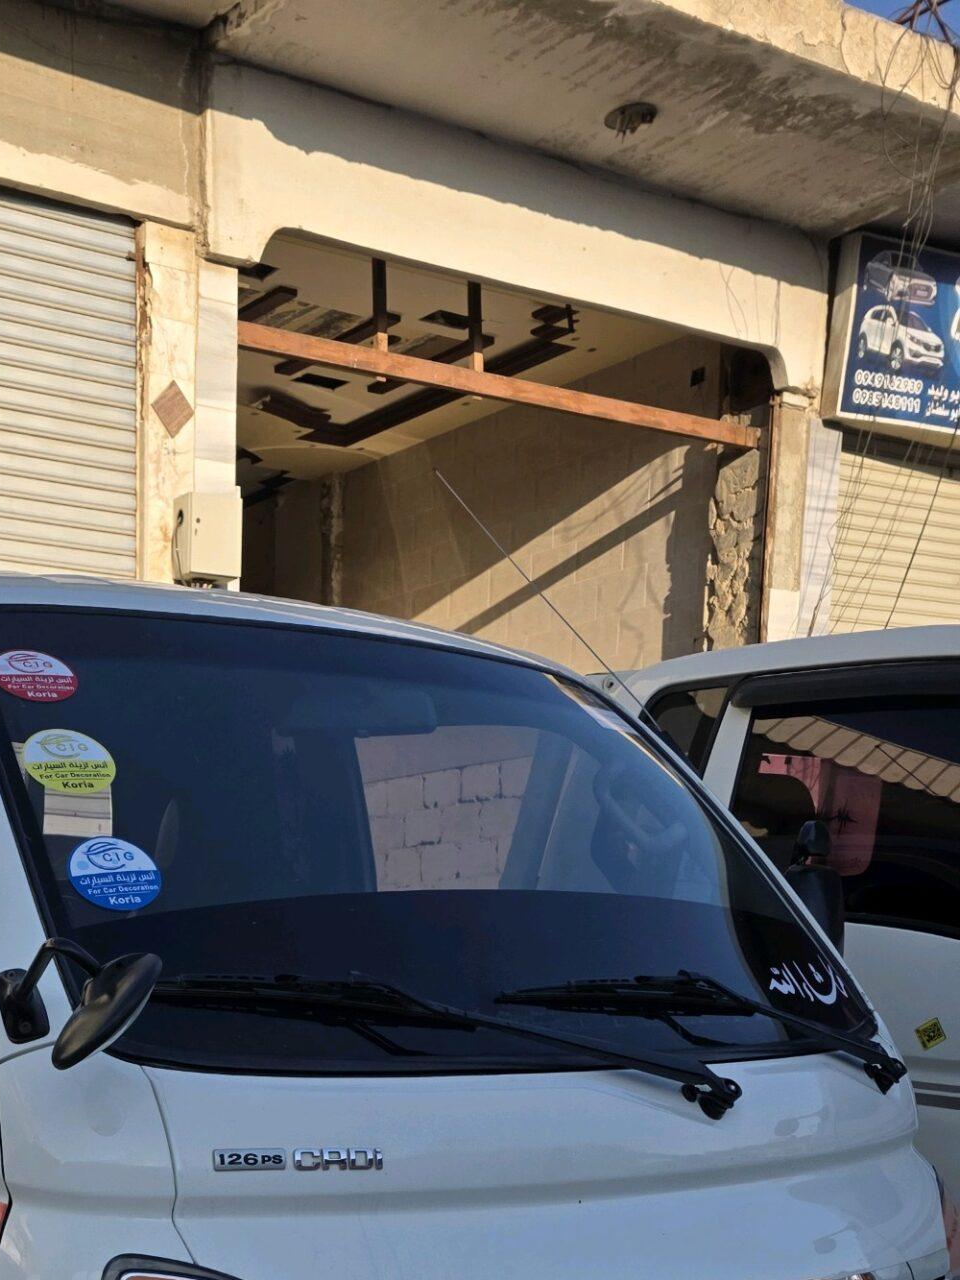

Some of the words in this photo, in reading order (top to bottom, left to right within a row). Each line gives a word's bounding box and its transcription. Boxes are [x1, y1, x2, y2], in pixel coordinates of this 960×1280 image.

[27, 690, 59, 699] Koria
[61, 781, 94, 789] Koria
[80, 875, 114, 886] السيارات
[118, 884, 159, 892] Decoration
[108, 895, 142, 905] Koria
[769, 962, 807, 999] الله
